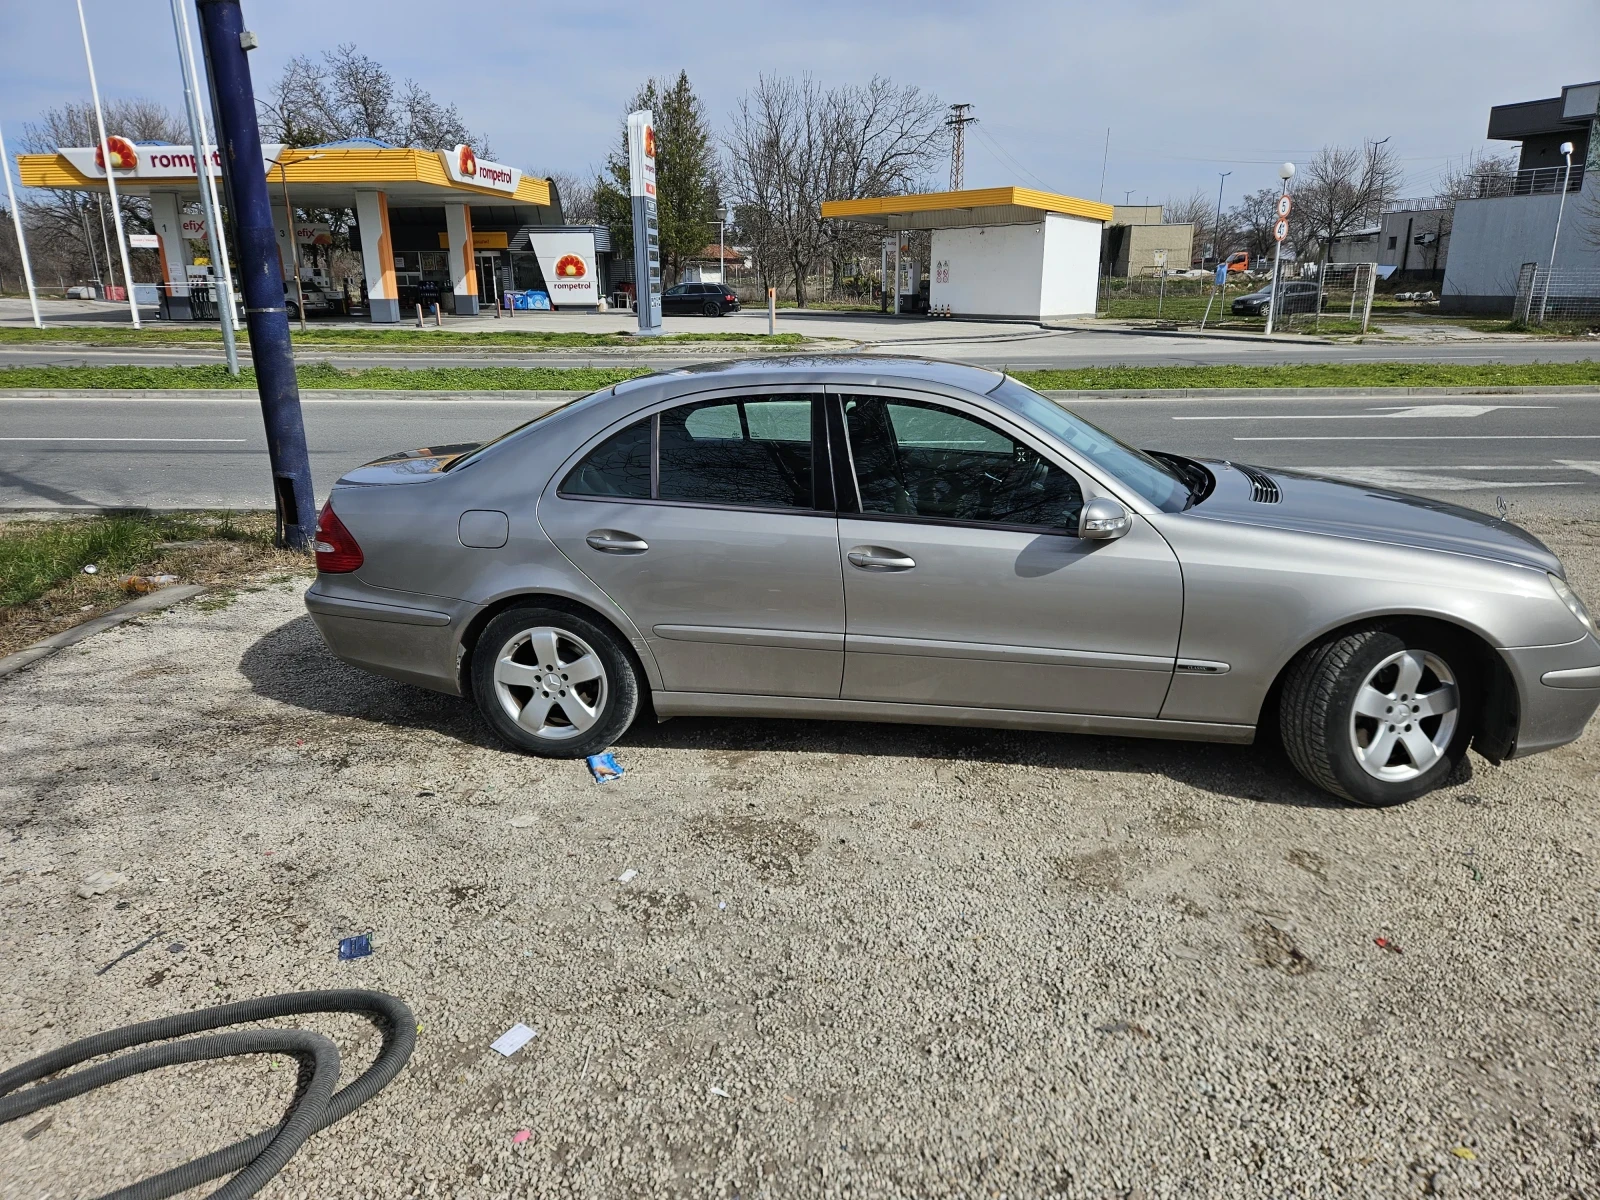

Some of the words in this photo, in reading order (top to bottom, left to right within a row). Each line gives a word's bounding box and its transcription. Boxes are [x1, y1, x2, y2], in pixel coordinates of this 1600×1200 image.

[480, 167, 511, 186] rompetrol
[1282, 201, 1286, 212] 5
[162, 223, 168, 233] 1
[183, 220, 205, 232] efix
[279, 229, 286, 238] 3
[297, 228, 316, 239] efix
[554, 281, 591, 291] rompetrol
[328, 301, 335, 310] 3
